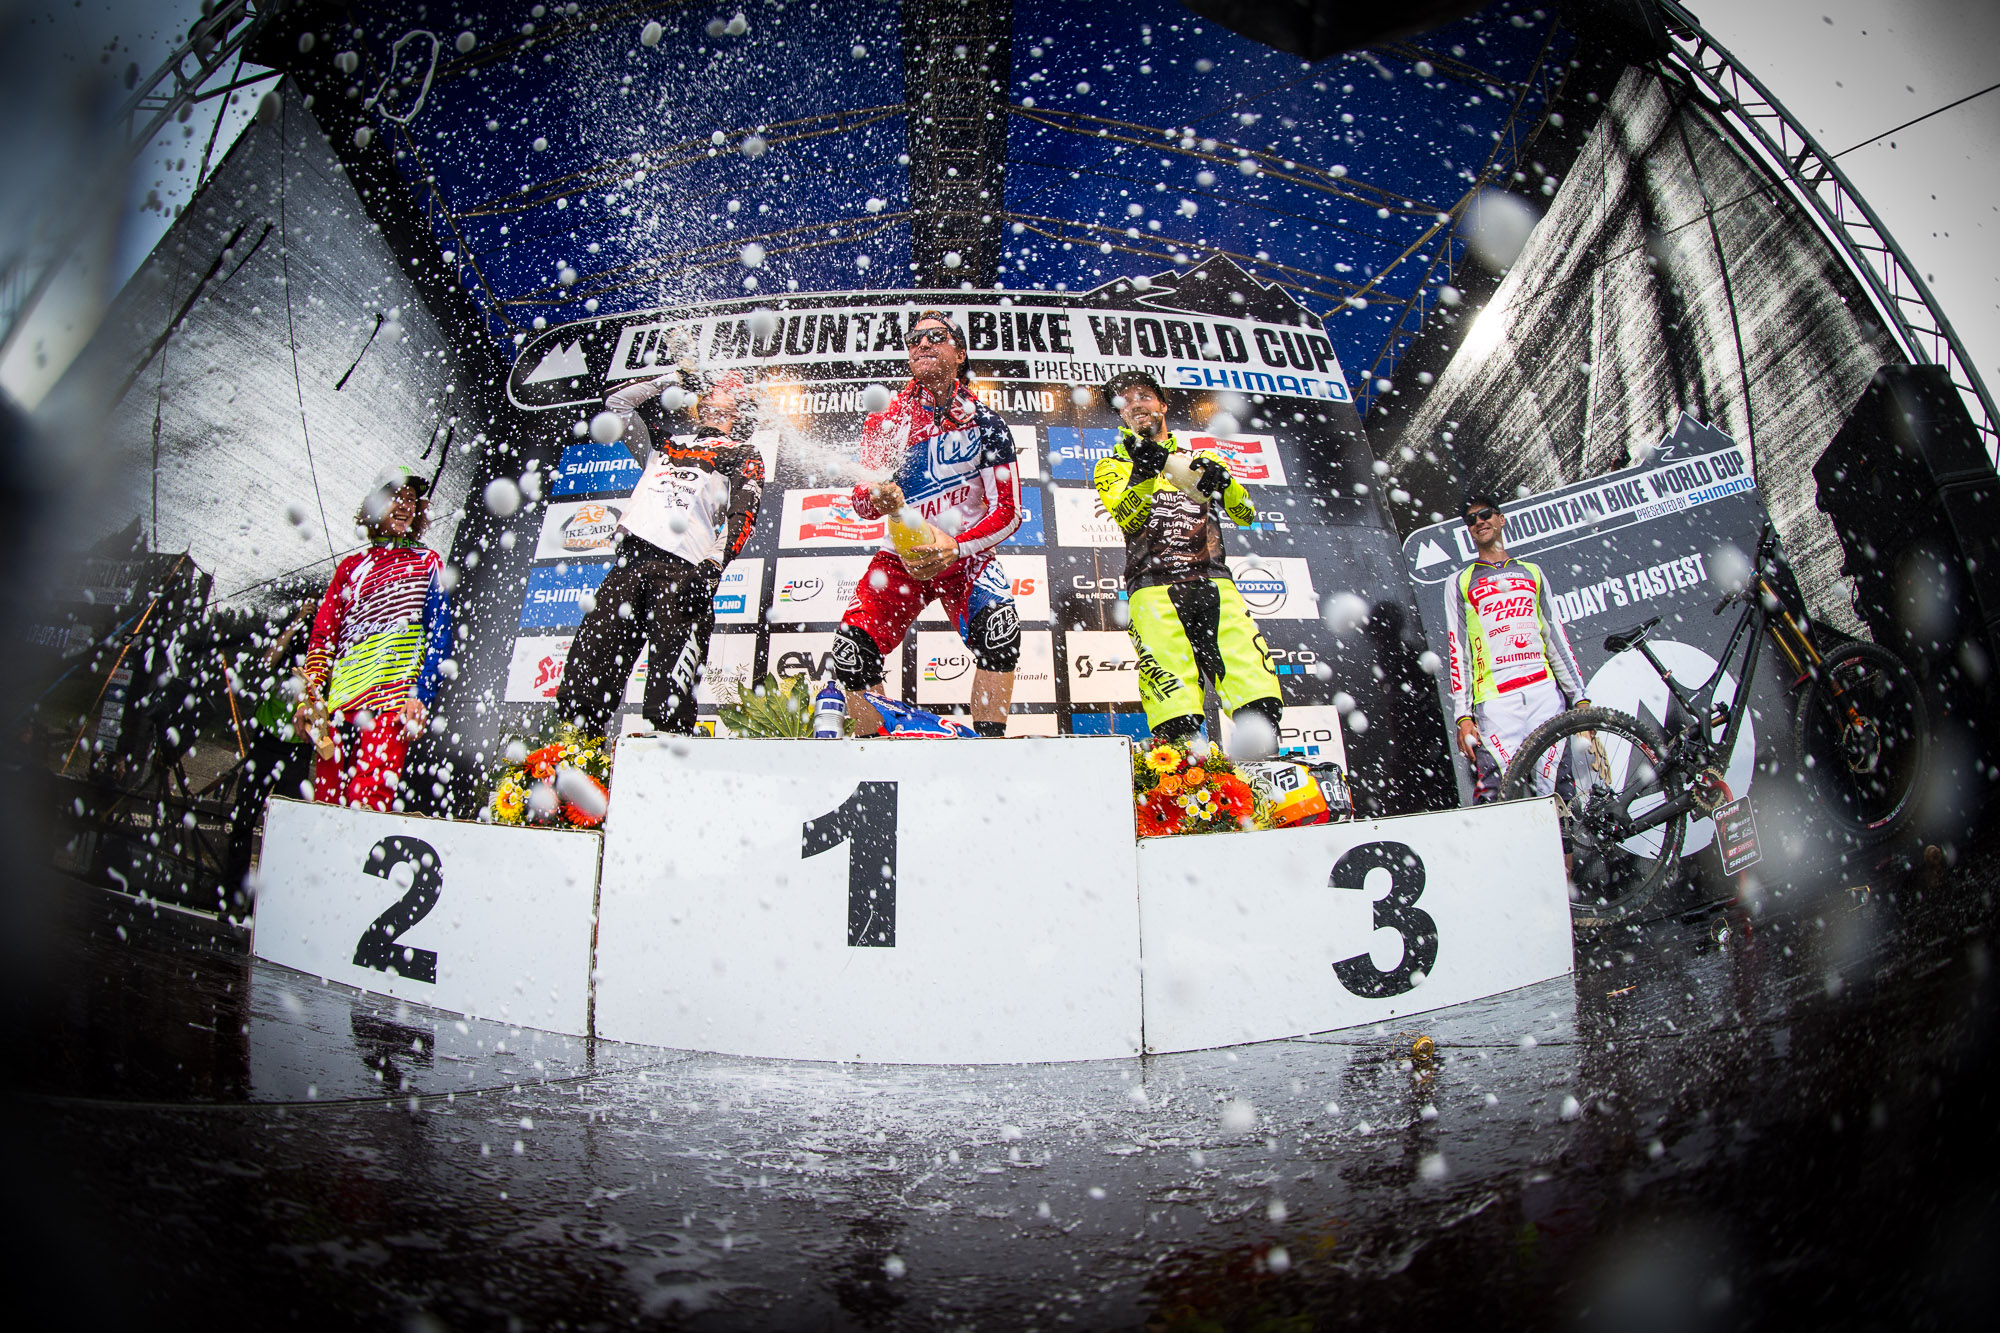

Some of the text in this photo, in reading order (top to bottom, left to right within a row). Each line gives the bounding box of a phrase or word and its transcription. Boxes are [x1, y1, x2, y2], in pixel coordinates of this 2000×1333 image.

[968, 311, 1074, 355] BIKE
[1088, 315, 1250, 364] WORLD
[1253, 327, 1335, 374] CUP
[1176, 366, 1348, 401] SHIMANO
[1060, 446, 1114, 460] SHIM
[1503, 491, 1605, 544] MOUNTAIN
[1602, 478, 1649, 512] BIKE
[1647, 460, 1713, 499] WORLD
[1709, 450, 1745, 481] CUP
[1636, 477, 1755, 520] PRESENTED BY SHIMANO
[1235, 583, 1284, 591] VOLVO
[1552, 552, 1708, 625] ODAY'S FASTEST
[1482, 596, 1534, 617] SANTA
[1495, 606, 1534, 622] CRUZ
[534, 655, 564, 689] Sti
[1495, 652, 1541, 665] SHIMANO
[1715, 804, 1740, 821] GWIN
[801, 780, 898, 948] 1
[352, 834, 444, 984] 2
[1328, 840, 1439, 999] 3
